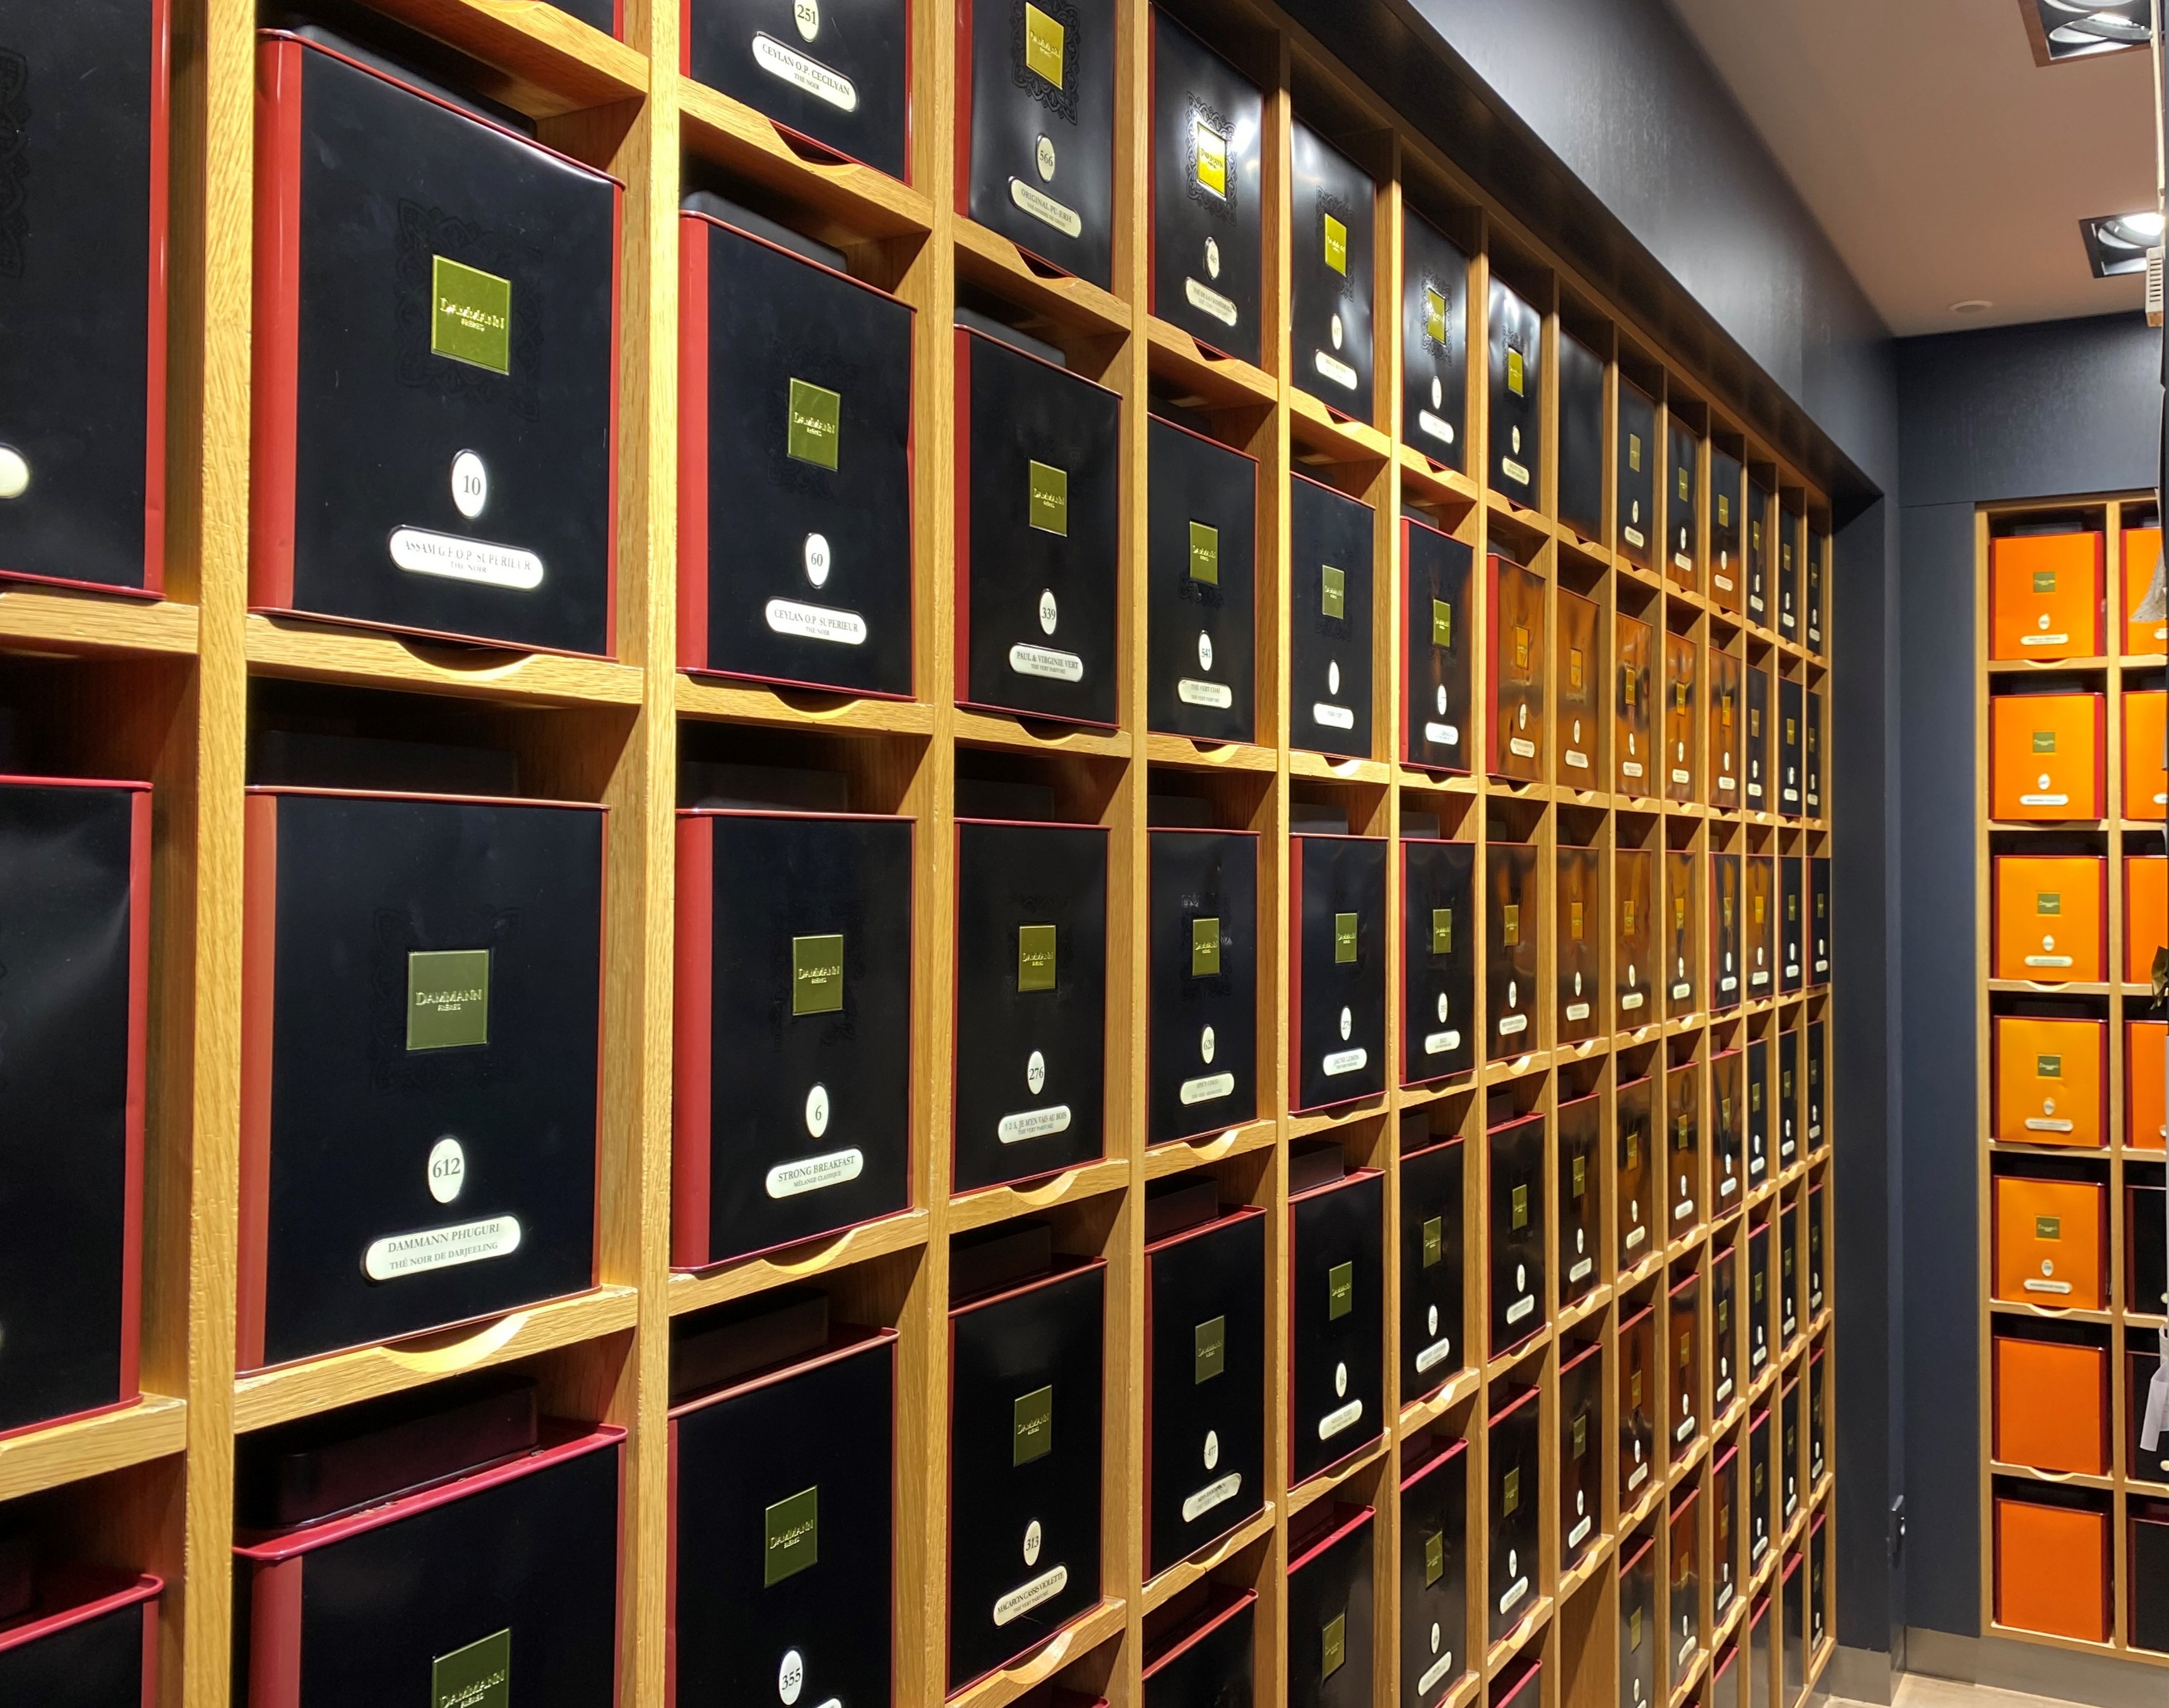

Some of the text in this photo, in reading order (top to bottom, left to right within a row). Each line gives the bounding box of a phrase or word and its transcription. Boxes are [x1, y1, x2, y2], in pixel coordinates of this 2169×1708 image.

[797, 4, 816, 25] 251
[762, 44, 794, 67] CEYLAN
[811, 69, 850, 96] CECILYAN
[806, 78, 820, 91] NOIR
[1039, 150, 1054, 167] 566
[1021, 189, 1072, 223] ORIGINAL PU-ERH
[463, 475, 481, 495] 10
[405, 540, 436, 555] ASSAM
[811, 552, 823, 567] 60
[468, 564, 487, 574] NOIR
[774, 608, 804, 622] CEYLAN
[1042, 607, 1056, 620] 339
[1016, 651, 1032, 661] PAUL
[1038, 655, 1064, 667] VIRGINIE
[1064, 660, 1079, 670] VERT
[1201, 648, 1211, 658] 541
[415, 989, 482, 1005] DAMMANN
[1203, 1038, 1215, 1050] 620
[1029, 1066, 1044, 1081] 276
[815, 1105, 822, 1121] 6
[1038, 1115, 1049, 1123] VAIS
[1055, 1112, 1067, 1120] BOIS
[432, 1157, 461, 1178] 612
[778, 1155, 855, 1182] STRONG BREAKFAST
[793, 1170, 842, 1188] MÉLANGE CLASSIQUE
[388, 1223, 499, 1253] DAMMANN PHUGURI
[410, 1255, 432, 1267] NOIR
[434, 1252, 446, 1261] DE
[448, 1242, 498, 1259] DARJEELING
[1025, 1535, 1039, 1551] 313
[997, 1571, 1065, 1615] MACARON CASSIS VIOLETTE
[781, 1667, 801, 1690] 355
